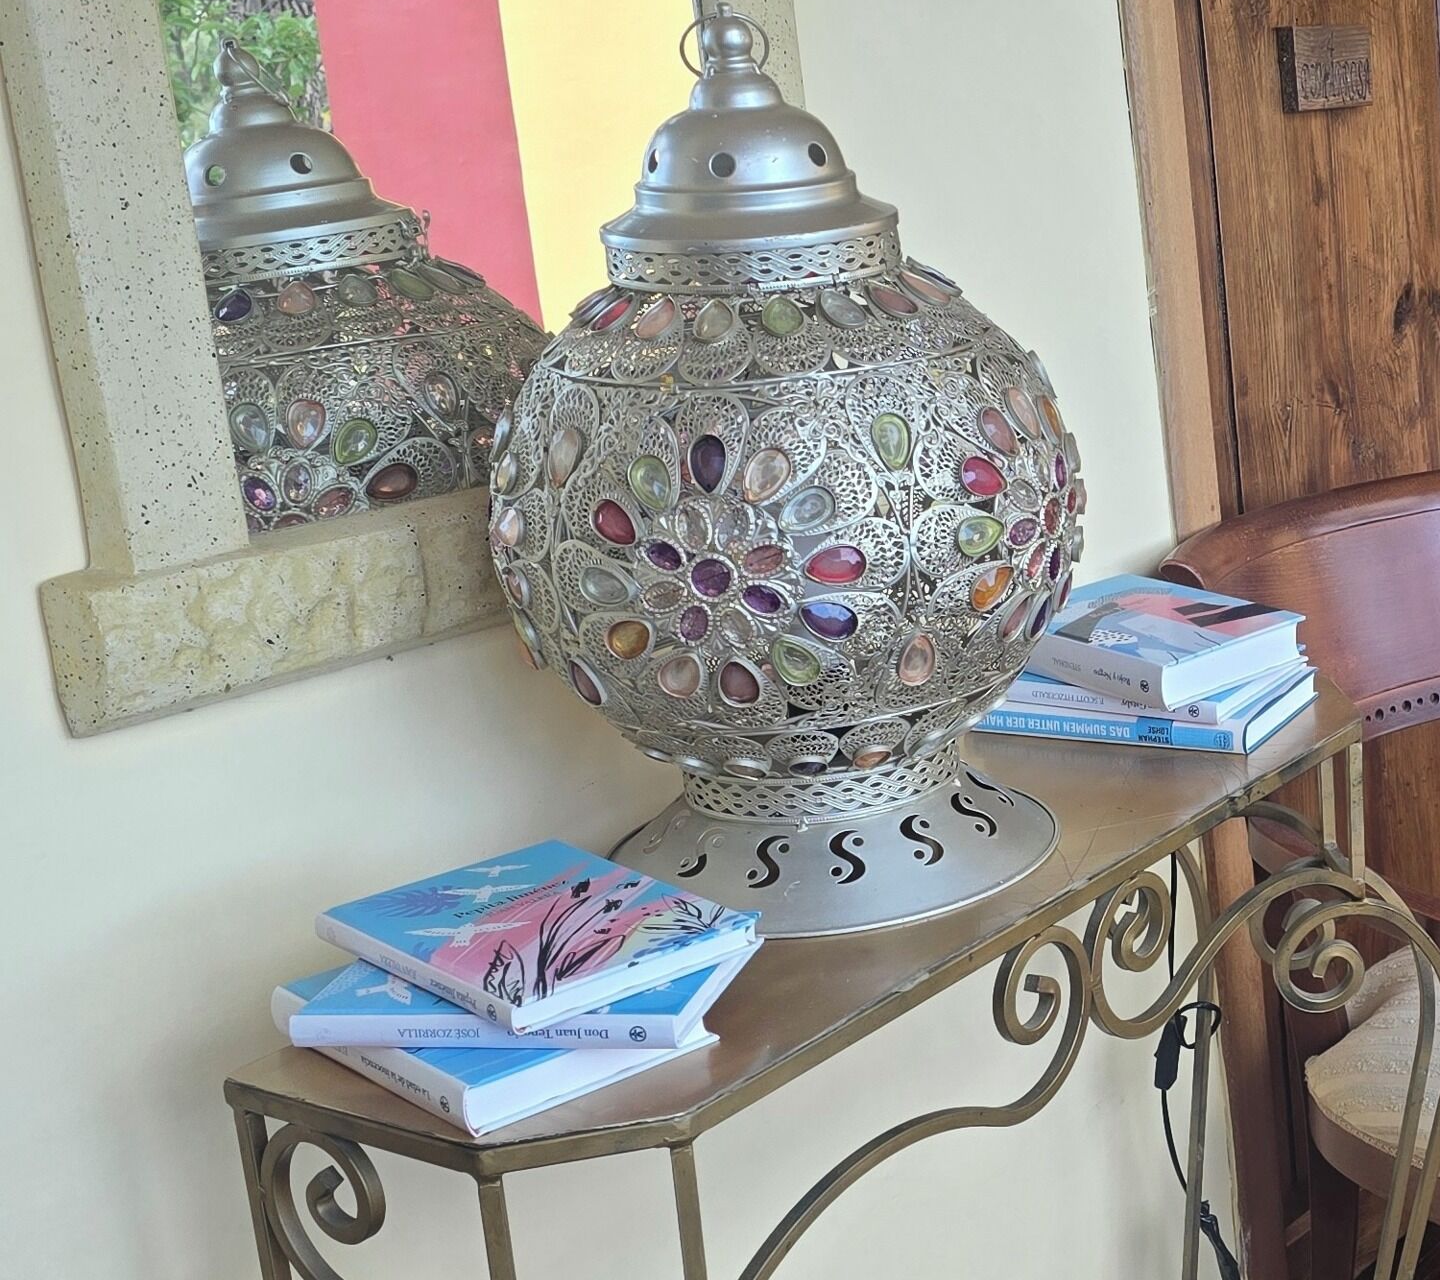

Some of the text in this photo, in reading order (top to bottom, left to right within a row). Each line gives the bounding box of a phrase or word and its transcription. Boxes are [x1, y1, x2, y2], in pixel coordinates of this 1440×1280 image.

[1031, 690, 1074, 702] FITZGERALD
[1006, 715, 1025, 729] DER
[1028, 718, 1060, 731] UNTER
[1063, 721, 1107, 736] SUMMEN
[1109, 725, 1130, 738] DAS
[1148, 726, 1169, 735] LOHSE
[1138, 735, 1170, 744] STEPHAN
[453, 881, 568, 919] Pepita Jiménez
[398, 1028, 480, 1040] JOSÉ ZORRILLA
[556, 1028, 581, 1039] Juan
[587, 1028, 609, 1039] Don
